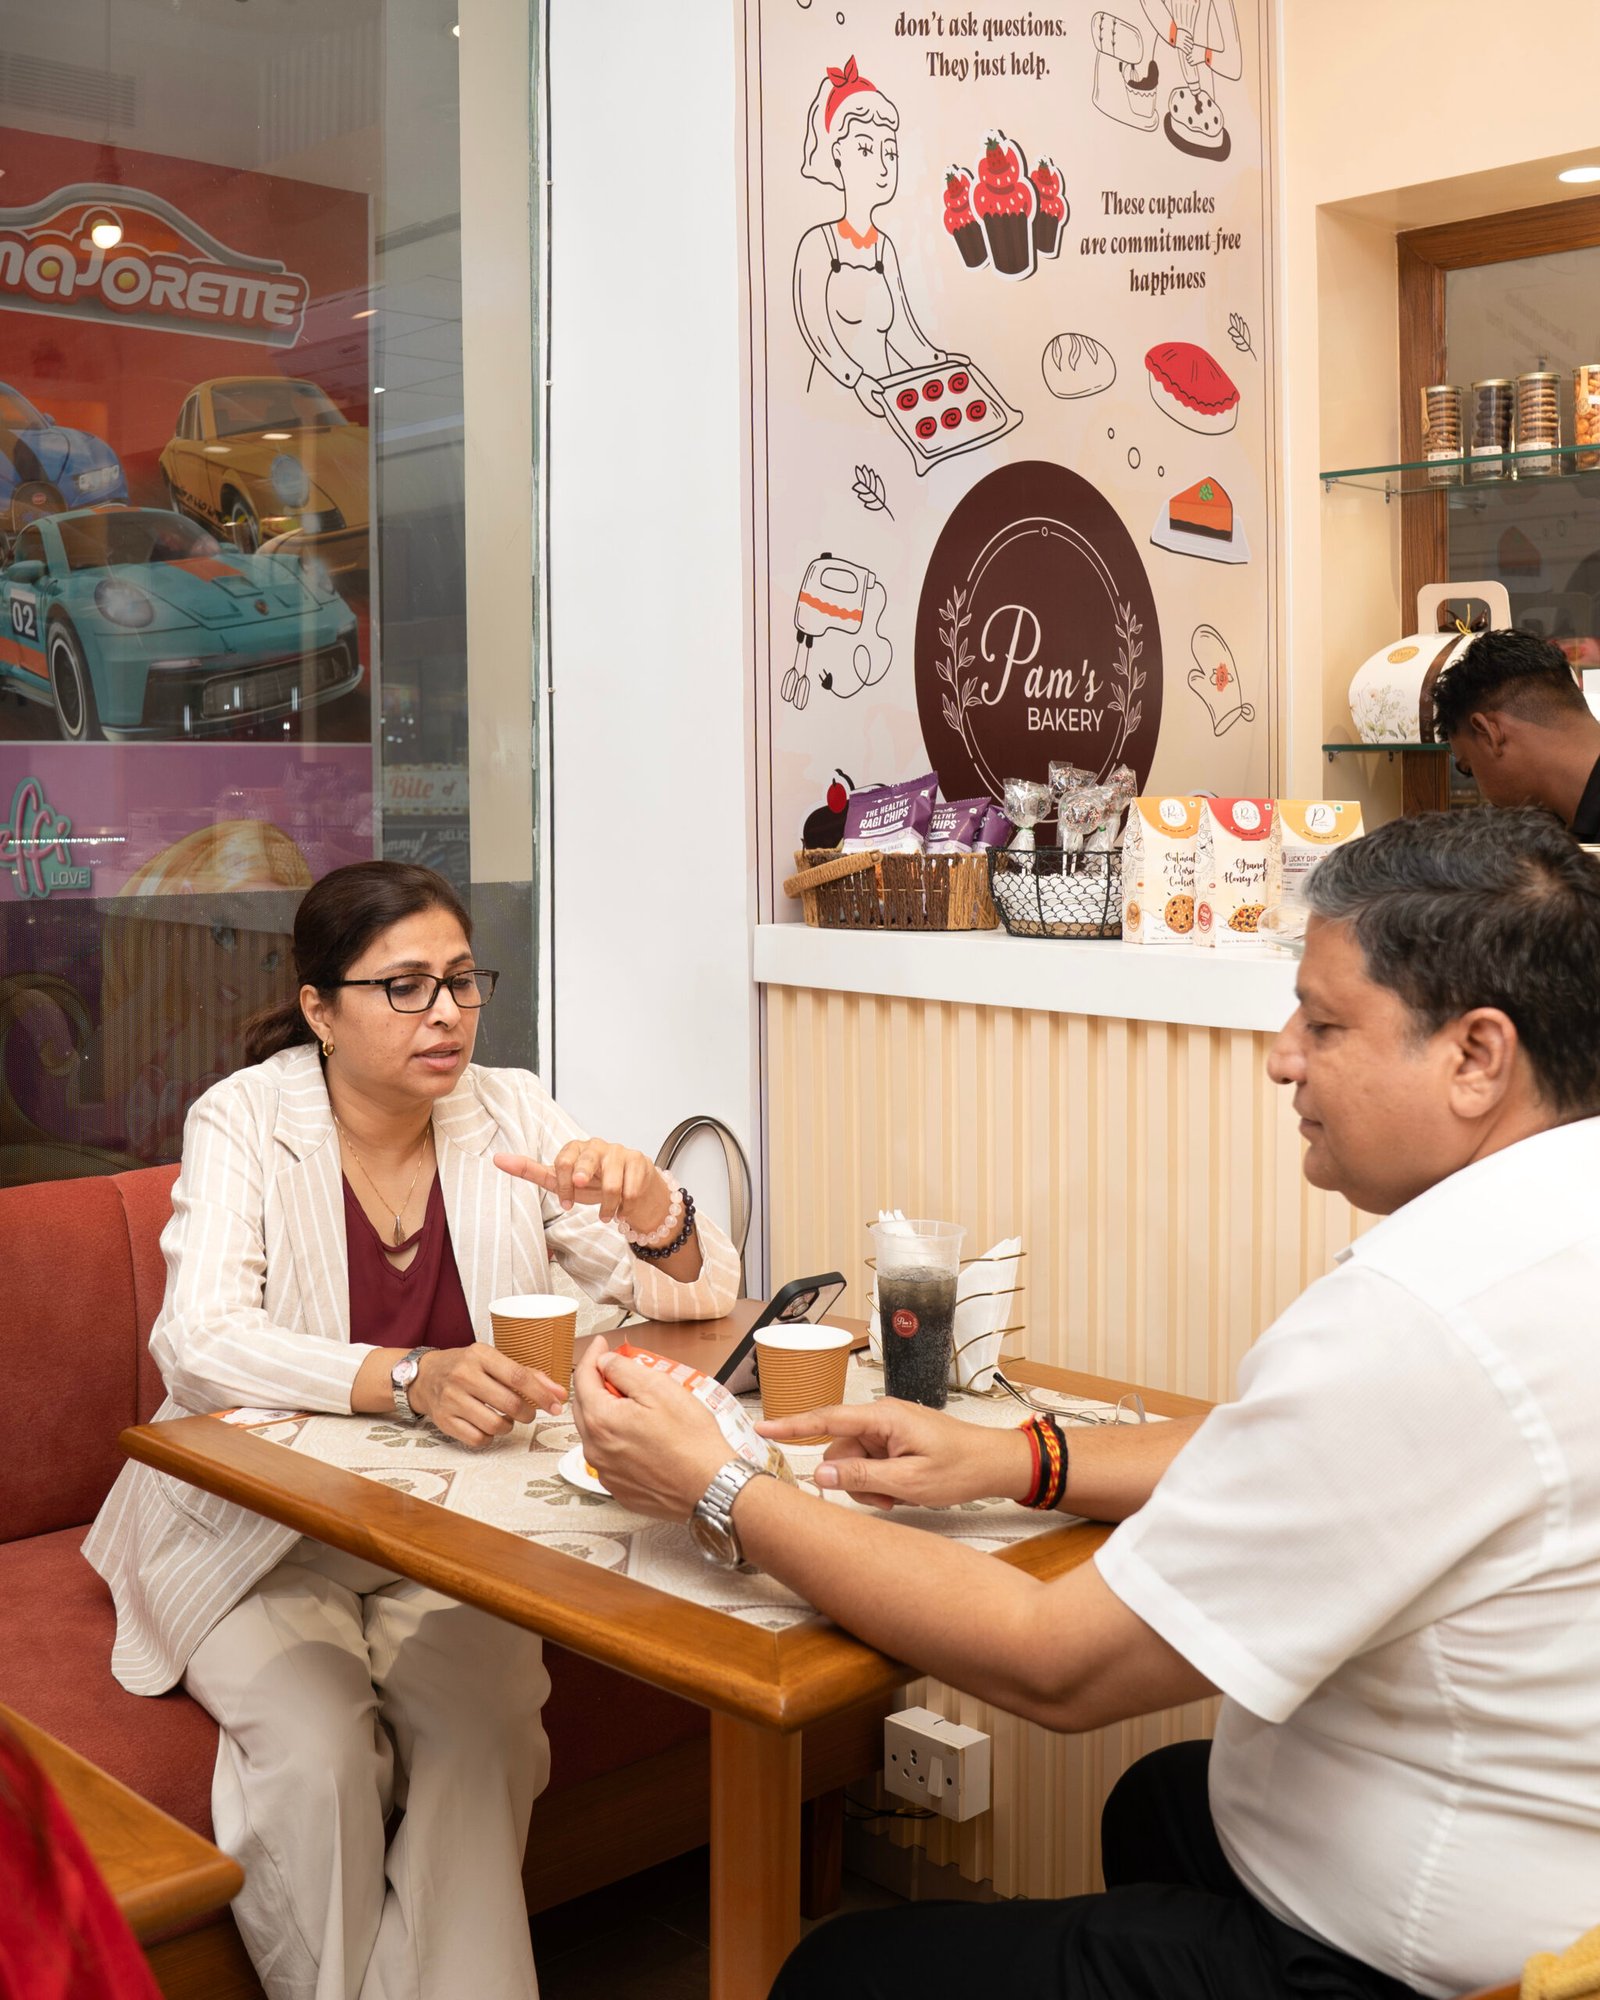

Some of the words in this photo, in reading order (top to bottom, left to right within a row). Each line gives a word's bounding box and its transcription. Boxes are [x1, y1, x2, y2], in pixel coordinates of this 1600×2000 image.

[895, 11, 945, 37] don't
[949, 11, 979, 37] ask
[982, 11, 1067, 42] questions.
[926, 51, 969, 82] They
[973, 50, 1006, 81] just
[1010, 51, 1050, 80] help.
[1101, 191, 1145, 215] These
[1148, 190, 1215, 219] cupcakes
[1080, 236, 1107, 255] are
[1110, 227, 1241, 255] commitment-free
[1129, 265, 1206, 296] happiness
[12, 602, 36, 637] 02
[980, 604, 1104, 706] Pam's
[1027, 707, 1104, 732] BAKERY
[859, 816, 882, 829] RAGI
[883, 806, 910, 825] CHIPS
[865, 808, 879, 818] THE
[880, 798, 910, 815] HEALTHY
[932, 812, 957, 820] ALTHY
[931, 820, 957, 830] HIPS
[51, 871, 87, 885] LOVE
[1224, 872, 1251, 887] Honey
